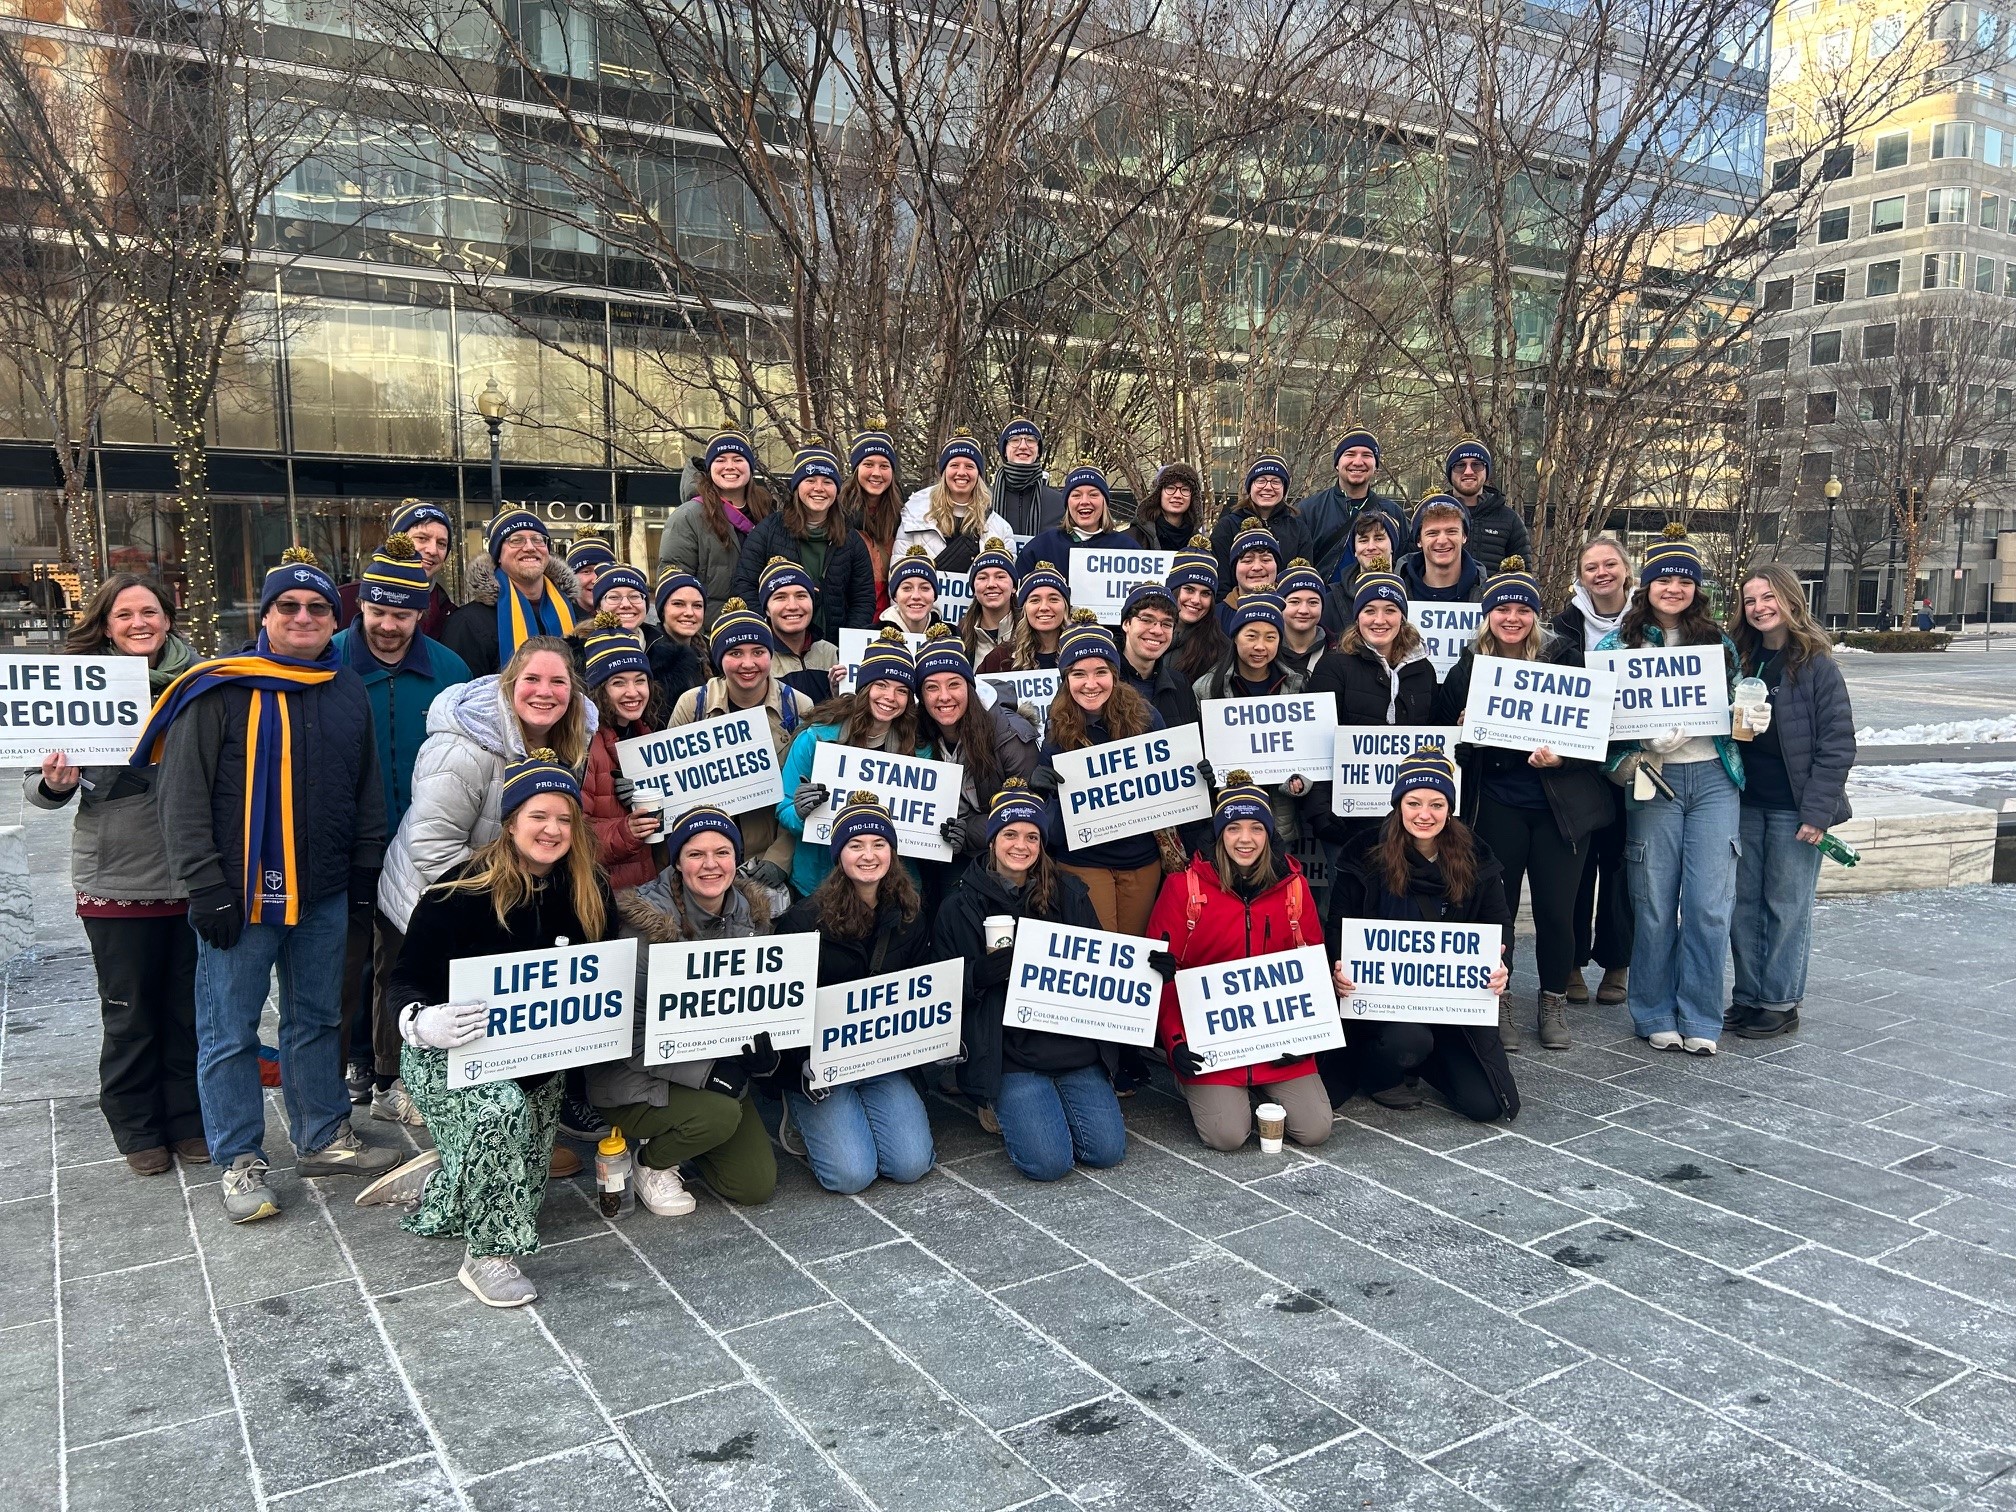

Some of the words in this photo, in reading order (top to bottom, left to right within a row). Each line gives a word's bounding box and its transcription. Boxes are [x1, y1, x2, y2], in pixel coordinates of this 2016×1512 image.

[1086, 555, 1164, 574] CHOOSE
[1106, 580, 1142, 598] LIF
[943, 604, 968, 622] LIF
[74, 665, 107, 690] IS
[1494, 666, 1502, 687] I
[1514, 669, 1592, 698] STAND
[1628, 655, 1702, 679] STAND
[1487, 695, 1533, 721] FOR
[1541, 703, 1590, 730] LIFE
[1661, 685, 1707, 708] LIFE
[1224, 701, 1316, 726] CHOOSE
[638, 731, 711, 768] VOICES
[712, 719, 752, 749] FOR
[1086, 746, 1138, 778] LIFE
[1144, 739, 1171, 765] IS
[1250, 731, 1294, 753] LIFE
[1352, 734, 1410, 755] VOICES
[674, 748, 771, 792] VOICELESS
[838, 755, 846, 777] I
[859, 758, 938, 792] STAND
[1341, 764, 1369, 784] THE
[1070, 765, 1197, 815] PRECIOUS
[889, 797, 936, 826] LIFE
[1048, 933, 1102, 964] LIFE
[1109, 942, 1136, 969] IS
[1364, 928, 1435, 953] VOICES
[1441, 931, 1480, 955] FOR
[494, 959, 558, 995] LIFE
[570, 954, 599, 985] IS
[687, 949, 746, 980] LIFE
[756, 946, 783, 974] IS
[1201, 976, 1211, 1000] I
[1222, 959, 1304, 996] STAND
[1350, 960, 1385, 984] THE
[1391, 962, 1491, 989] VOICELESS
[658, 981, 804, 1021] PRECIOUS
[847, 981, 899, 1015] LIFE
[908, 974, 933, 1001] IS
[1020, 963, 1152, 1007] PRECIOUS
[487, 990, 623, 1037] RECIOUS
[822, 1001, 952, 1052] PRECIOUS
[1205, 1004, 1256, 1035] FOR
[1263, 993, 1315, 1024] LIFE
[484, 1056, 528, 1068] COLORADO
[530, 1049, 573, 1061] CHRISTIAN
[574, 1040, 619, 1053] UNIVERSITY
[676, 1039, 717, 1048] COLORADO
[719, 1035, 755, 1044] CHRISTIA
[768, 1029, 801, 1037] IVERSITY
